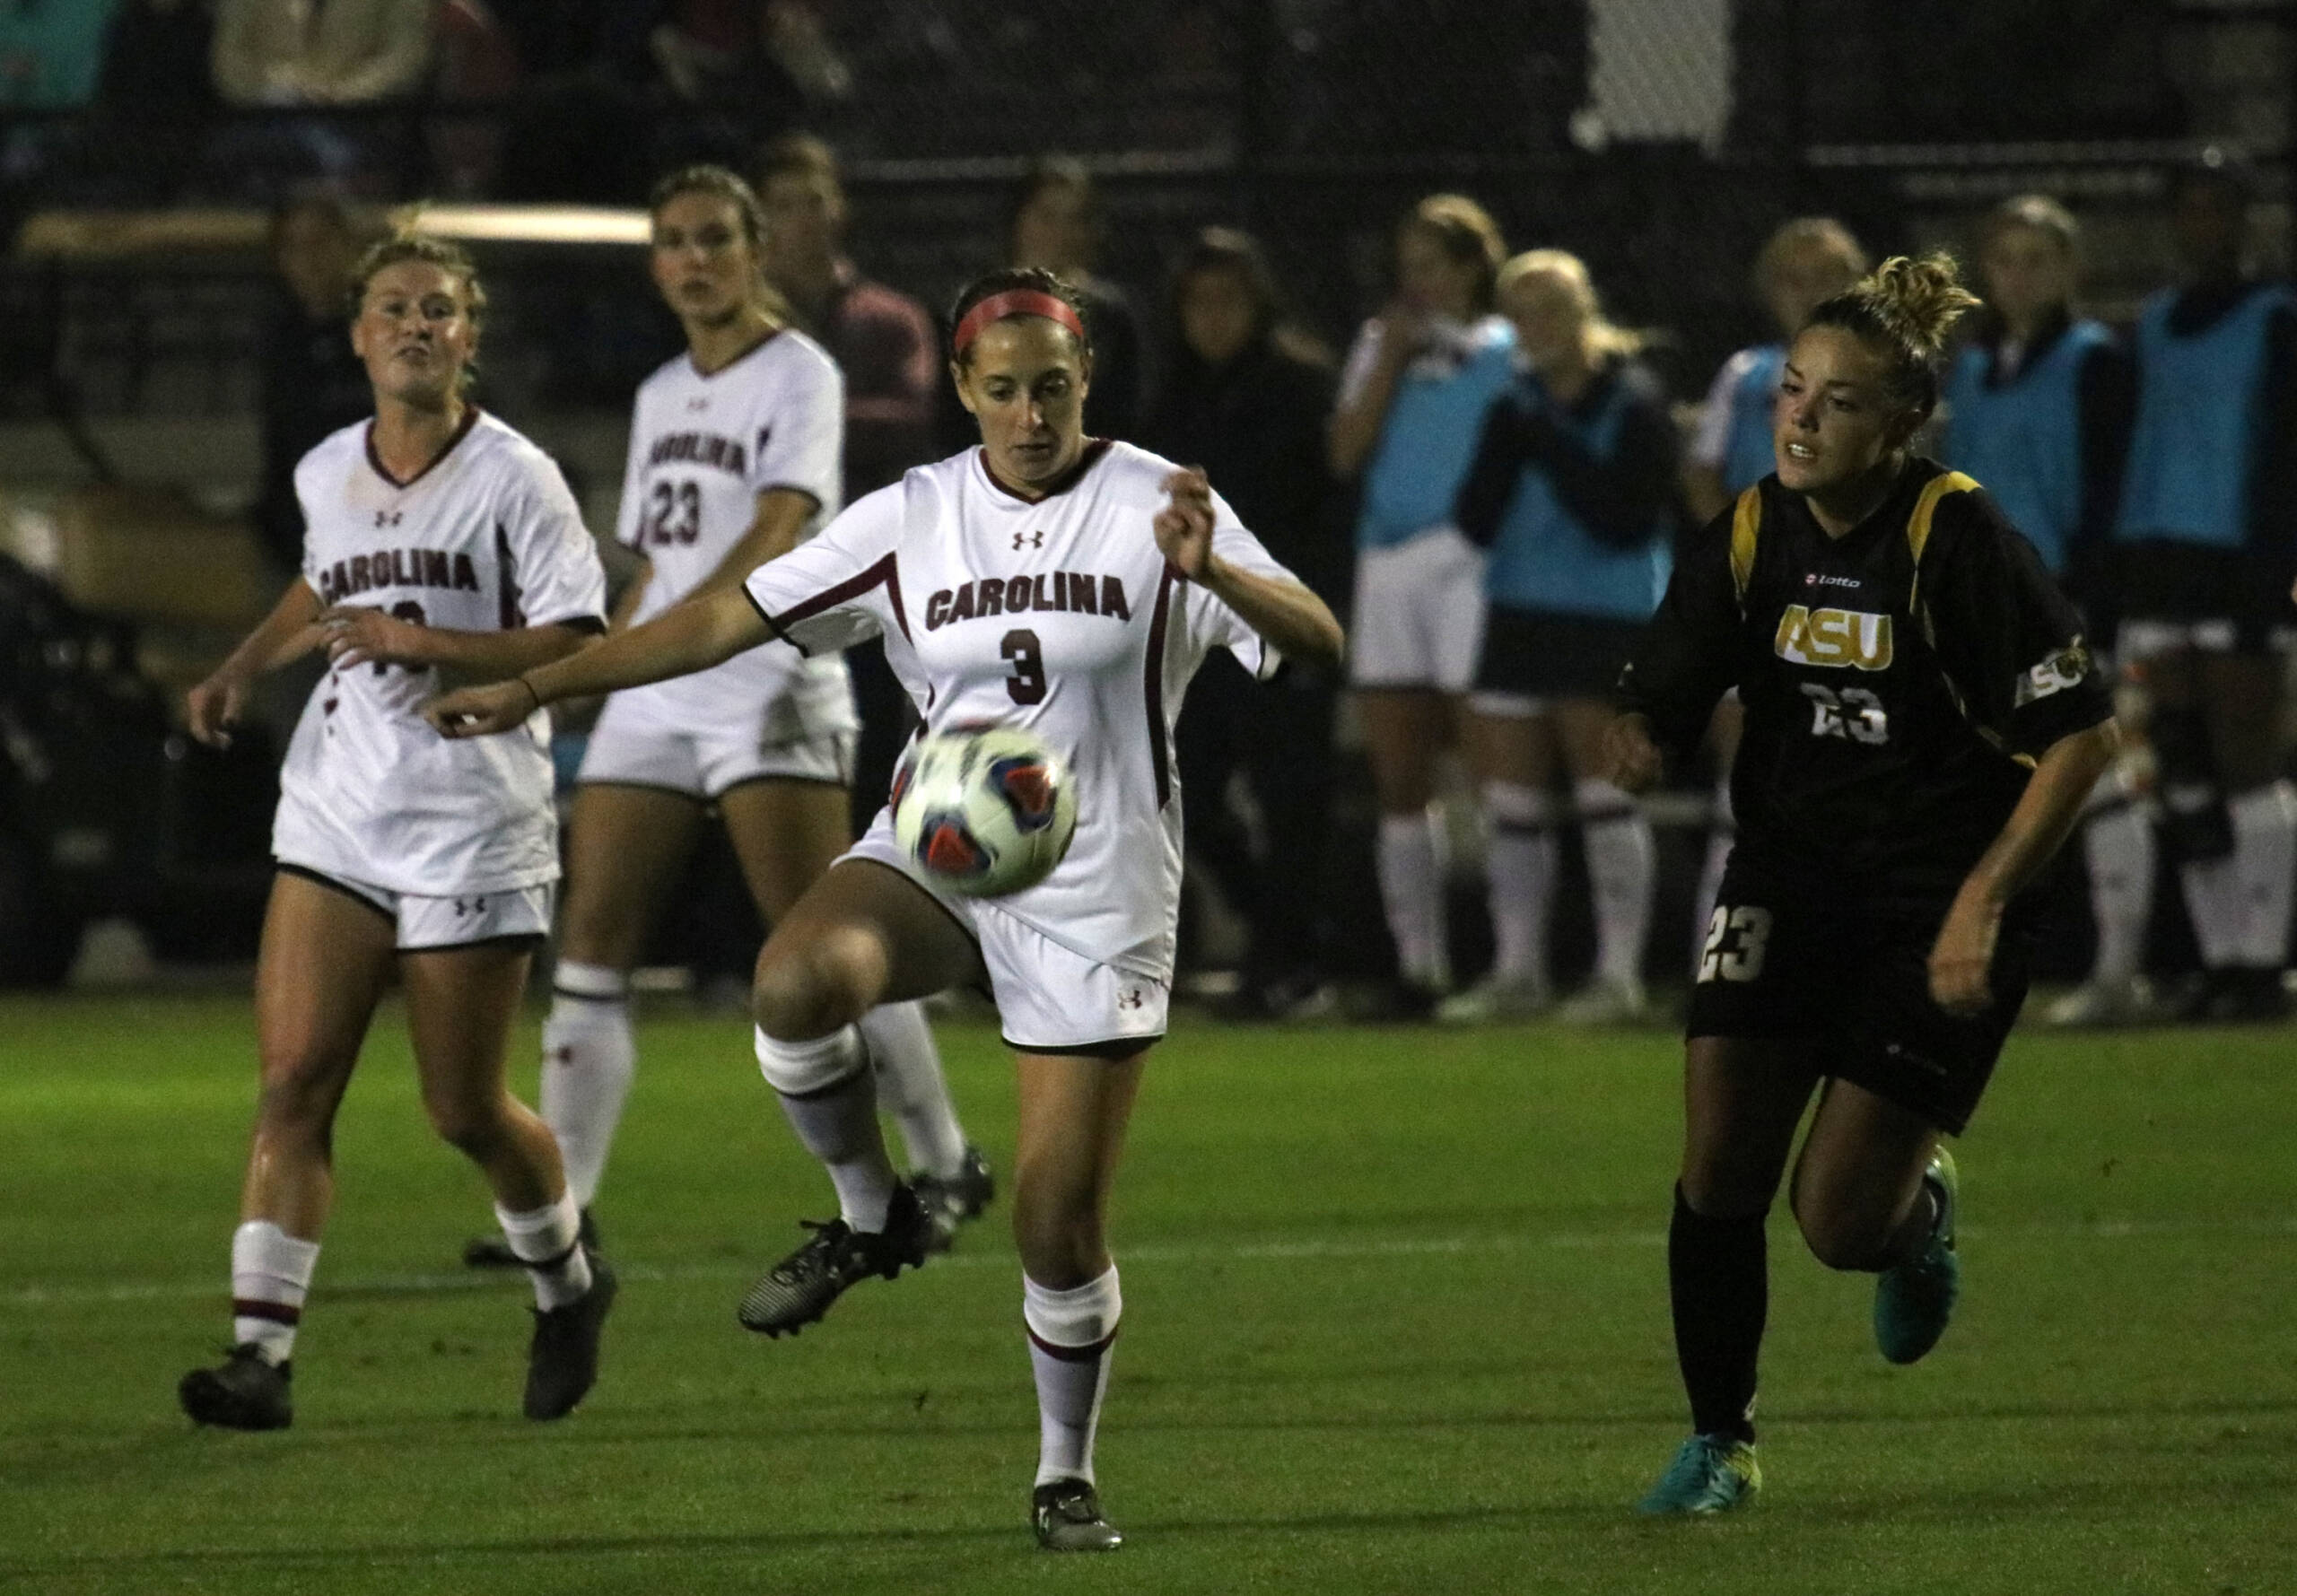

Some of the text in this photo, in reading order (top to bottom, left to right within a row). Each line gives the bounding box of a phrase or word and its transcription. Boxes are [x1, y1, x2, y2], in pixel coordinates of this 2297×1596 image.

[654, 482, 700, 545] 23
[320, 548, 478, 606] CAROLINA
[926, 571, 1130, 631] CAROLINA
[1000, 629, 1047, 705] 3
[1774, 603, 1894, 671] ASU
[1799, 682, 1890, 745] 23
[1697, 904, 1773, 983] 23
